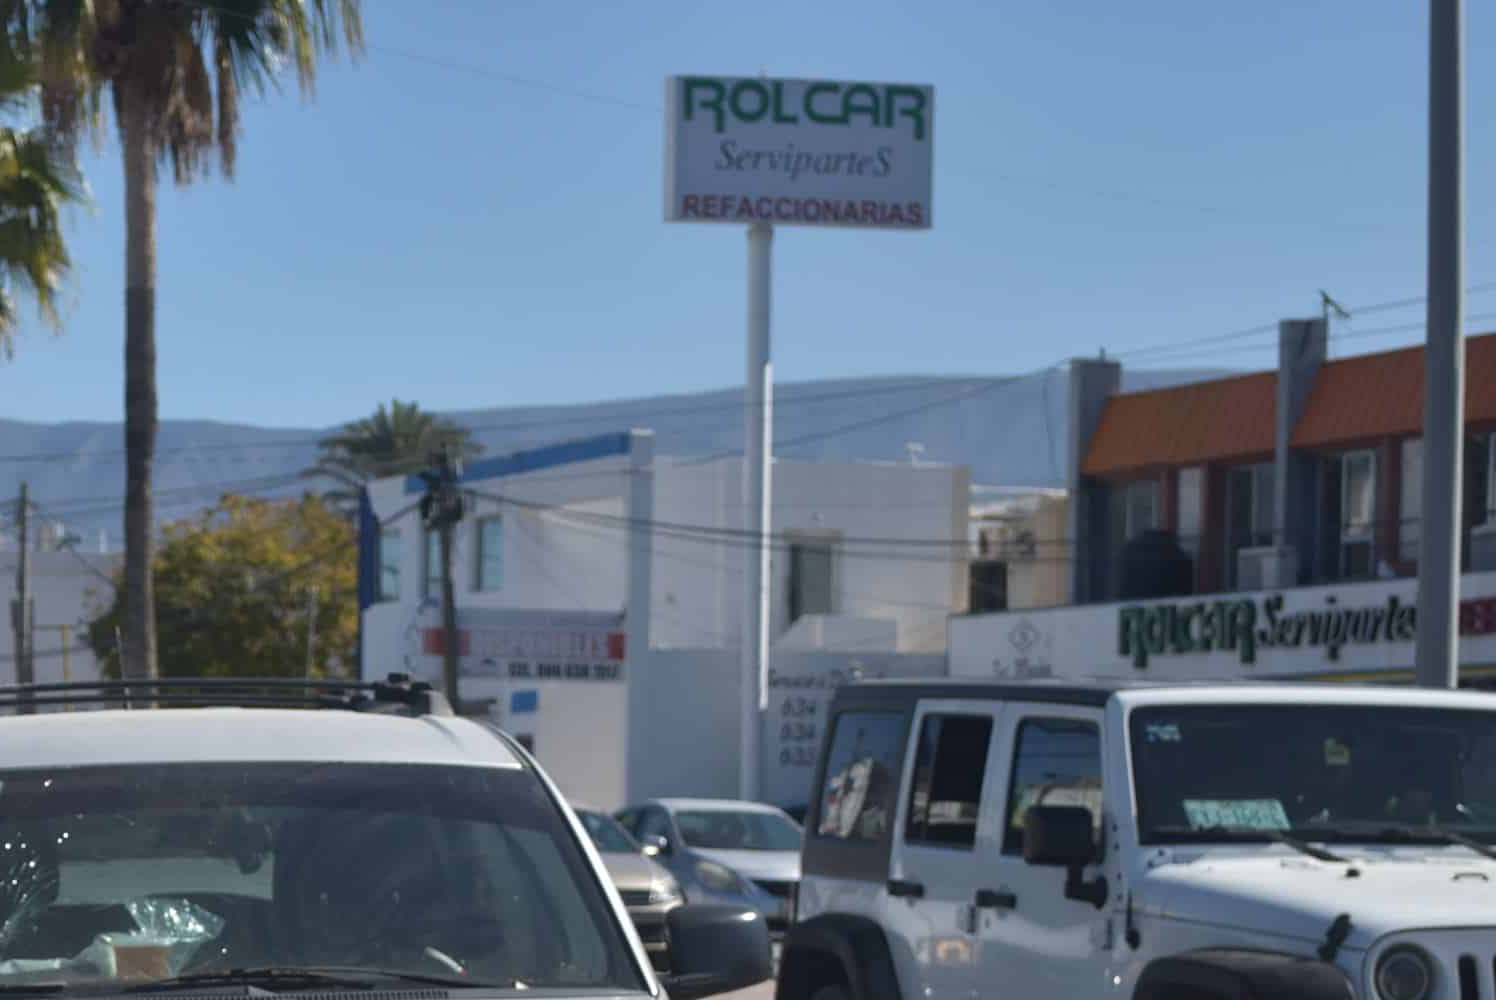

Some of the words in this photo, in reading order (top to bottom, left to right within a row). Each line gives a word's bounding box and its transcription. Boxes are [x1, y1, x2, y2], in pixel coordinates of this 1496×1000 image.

[681, 77, 927, 142] ROLCAR
[680, 194, 923, 225] REFACCIONARIAS
[1118, 599, 1256, 669] ROLCAR
